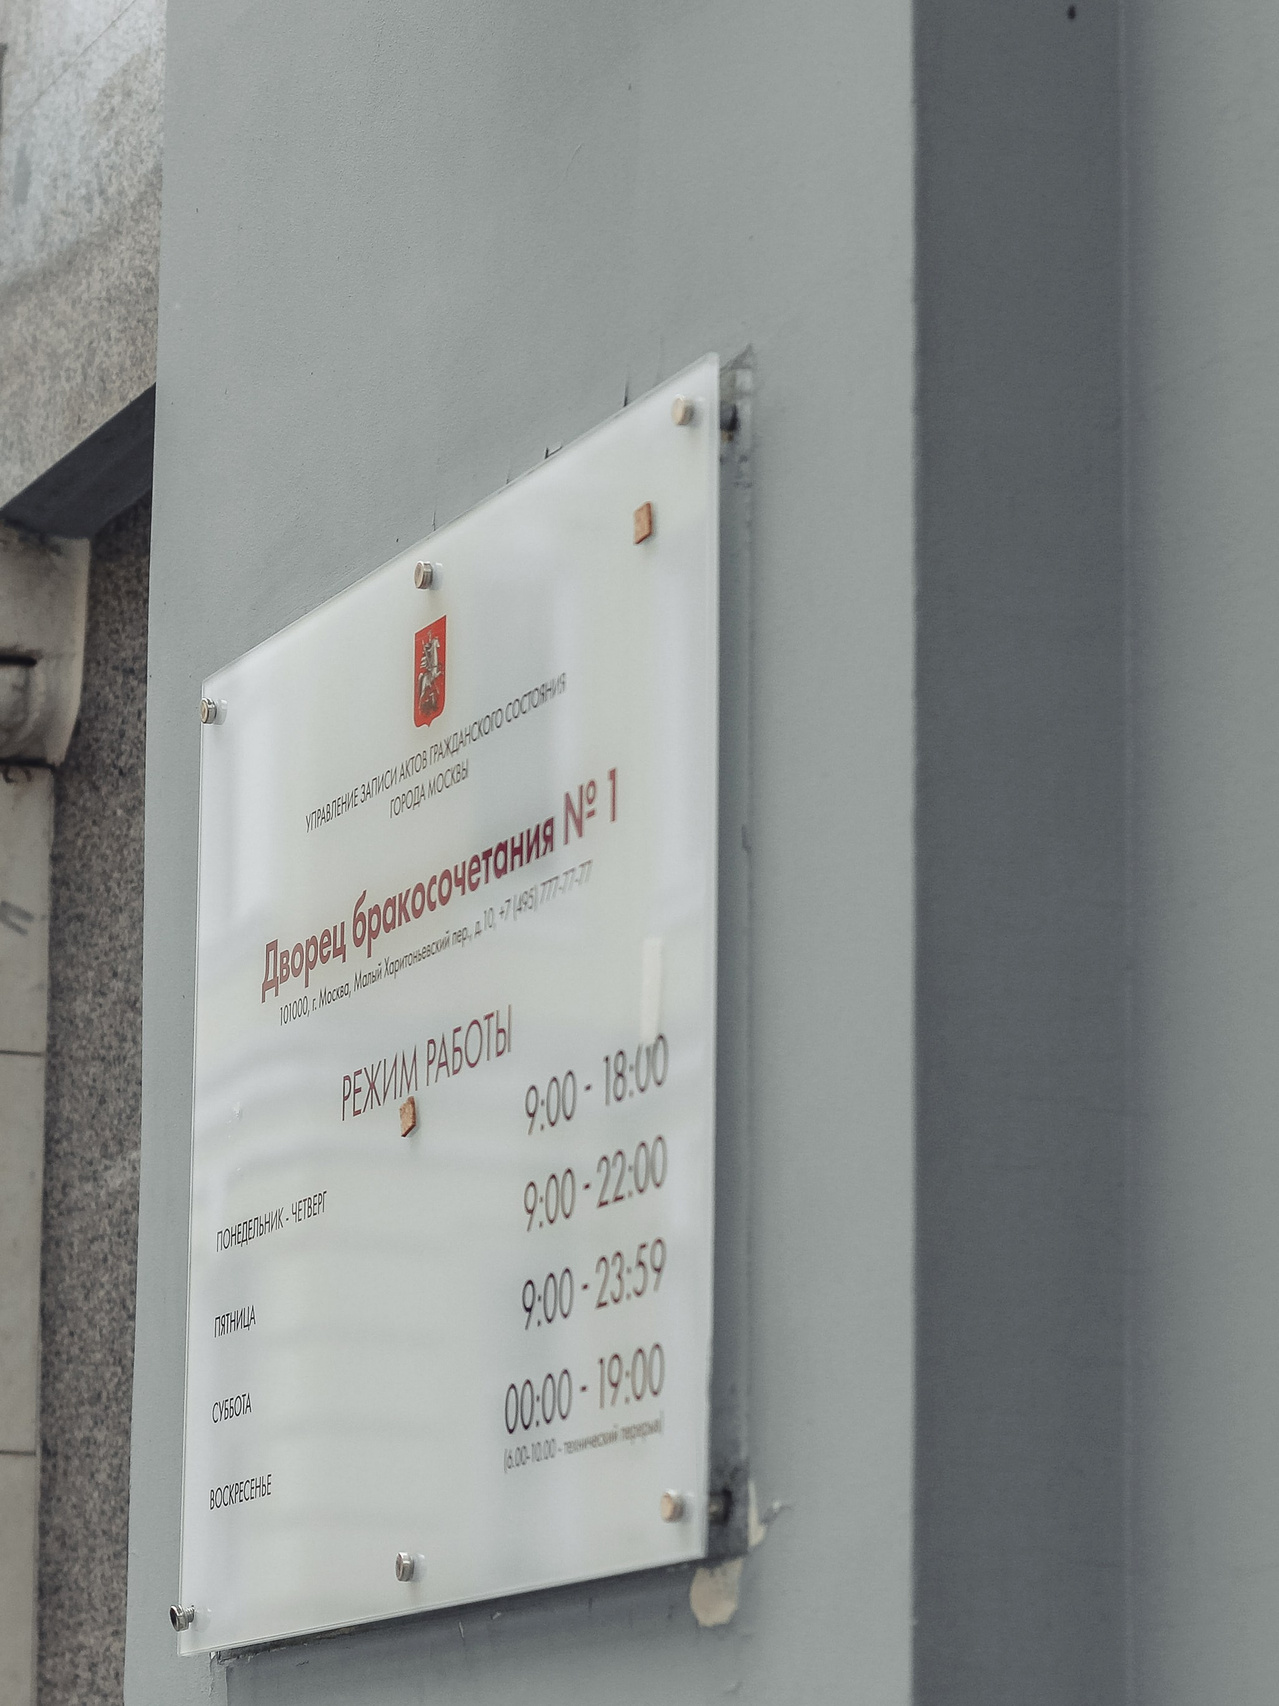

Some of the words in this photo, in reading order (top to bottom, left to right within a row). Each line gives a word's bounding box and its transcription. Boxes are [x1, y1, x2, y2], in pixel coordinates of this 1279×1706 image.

[305, 787, 359, 833] УПРАВЛЕНИЕ
[360, 766, 398, 803] ЗАПИСИ
[398, 750, 428, 783] АКТОВ
[428, 708, 504, 766] ГРАЖДАНСКОГО
[505, 672, 567, 723] СОСТОЯНИЯ
[389, 786, 426, 818] ГОРОДА
[427, 758, 469, 799] МОСКВЫ
[261, 921, 347, 1003] Дворец
[352, 816, 555, 958] бракосочетания
[608, 766, 617, 822] 1
[279, 995, 310, 1026] 101000,
[319, 982, 352, 1009] Москва,
[353, 963, 383, 992] Малый
[383, 930, 451, 979] Харитоньевский
[539, 859, 593, 905] 777-77-77
[342, 1045, 418, 1121] РЕЖИМ
[426, 1004, 512, 1087] РАБОТЫ
[525, 1070, 577, 1135] 9:00
[603, 1033, 669, 1106] 18:00
[216, 1207, 284, 1252] ПОНЕДЕЛЬНИК
[291, 1190, 328, 1223] ЧЕТВЕРГ
[523, 1167, 576, 1232] 9:00
[596, 1134, 668, 1209] 22:00
[214, 1304, 257, 1338] ПЯТНИЦА
[522, 1267, 574, 1330] 9:00
[595, 1237, 667, 1309] 23:59
[211, 1392, 252, 1424] СУББОТА
[504, 1368, 572, 1435] 00:00
[598, 1342, 665, 1409] 19:00
[209, 1473, 272, 1510] ВОСКРЕСЕНЬЕ
